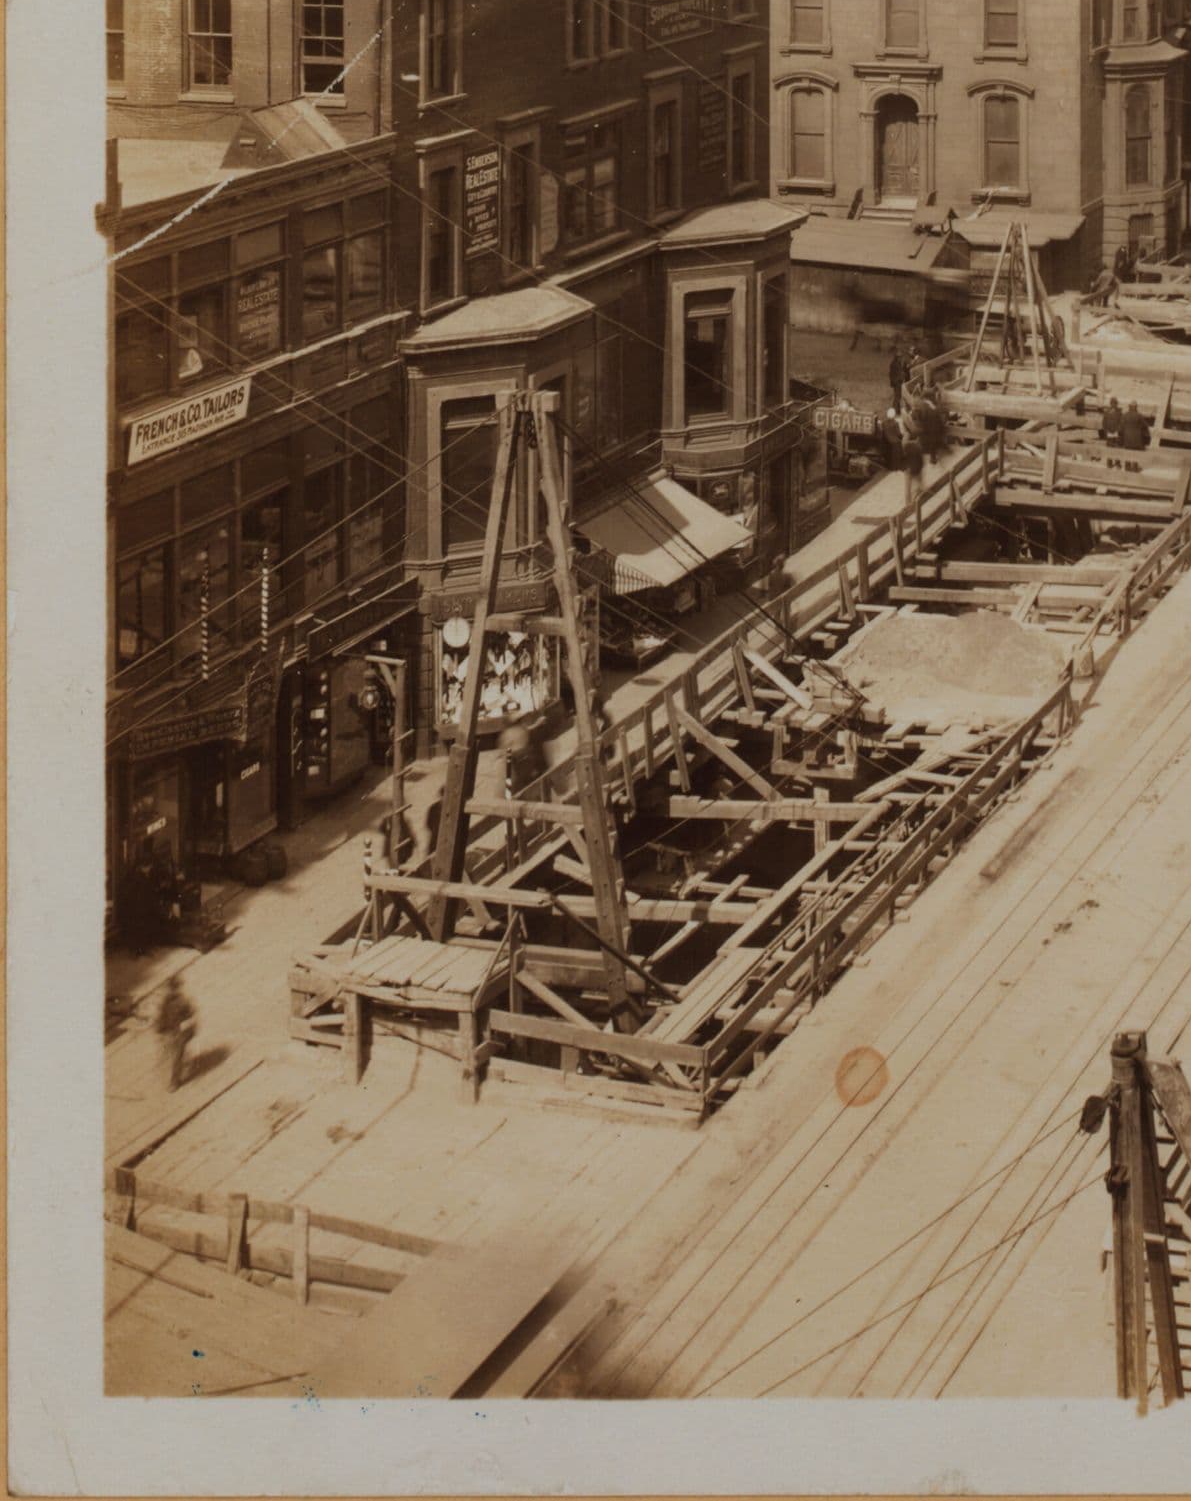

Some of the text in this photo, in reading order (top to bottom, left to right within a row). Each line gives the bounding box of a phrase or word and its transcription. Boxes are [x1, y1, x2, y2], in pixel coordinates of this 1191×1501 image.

[136, 411, 179, 446] FRENCH
[180, 408, 187, 428] &
[203, 386, 245, 419] TAILORS
[815, 410, 873, 431] CIGARS
